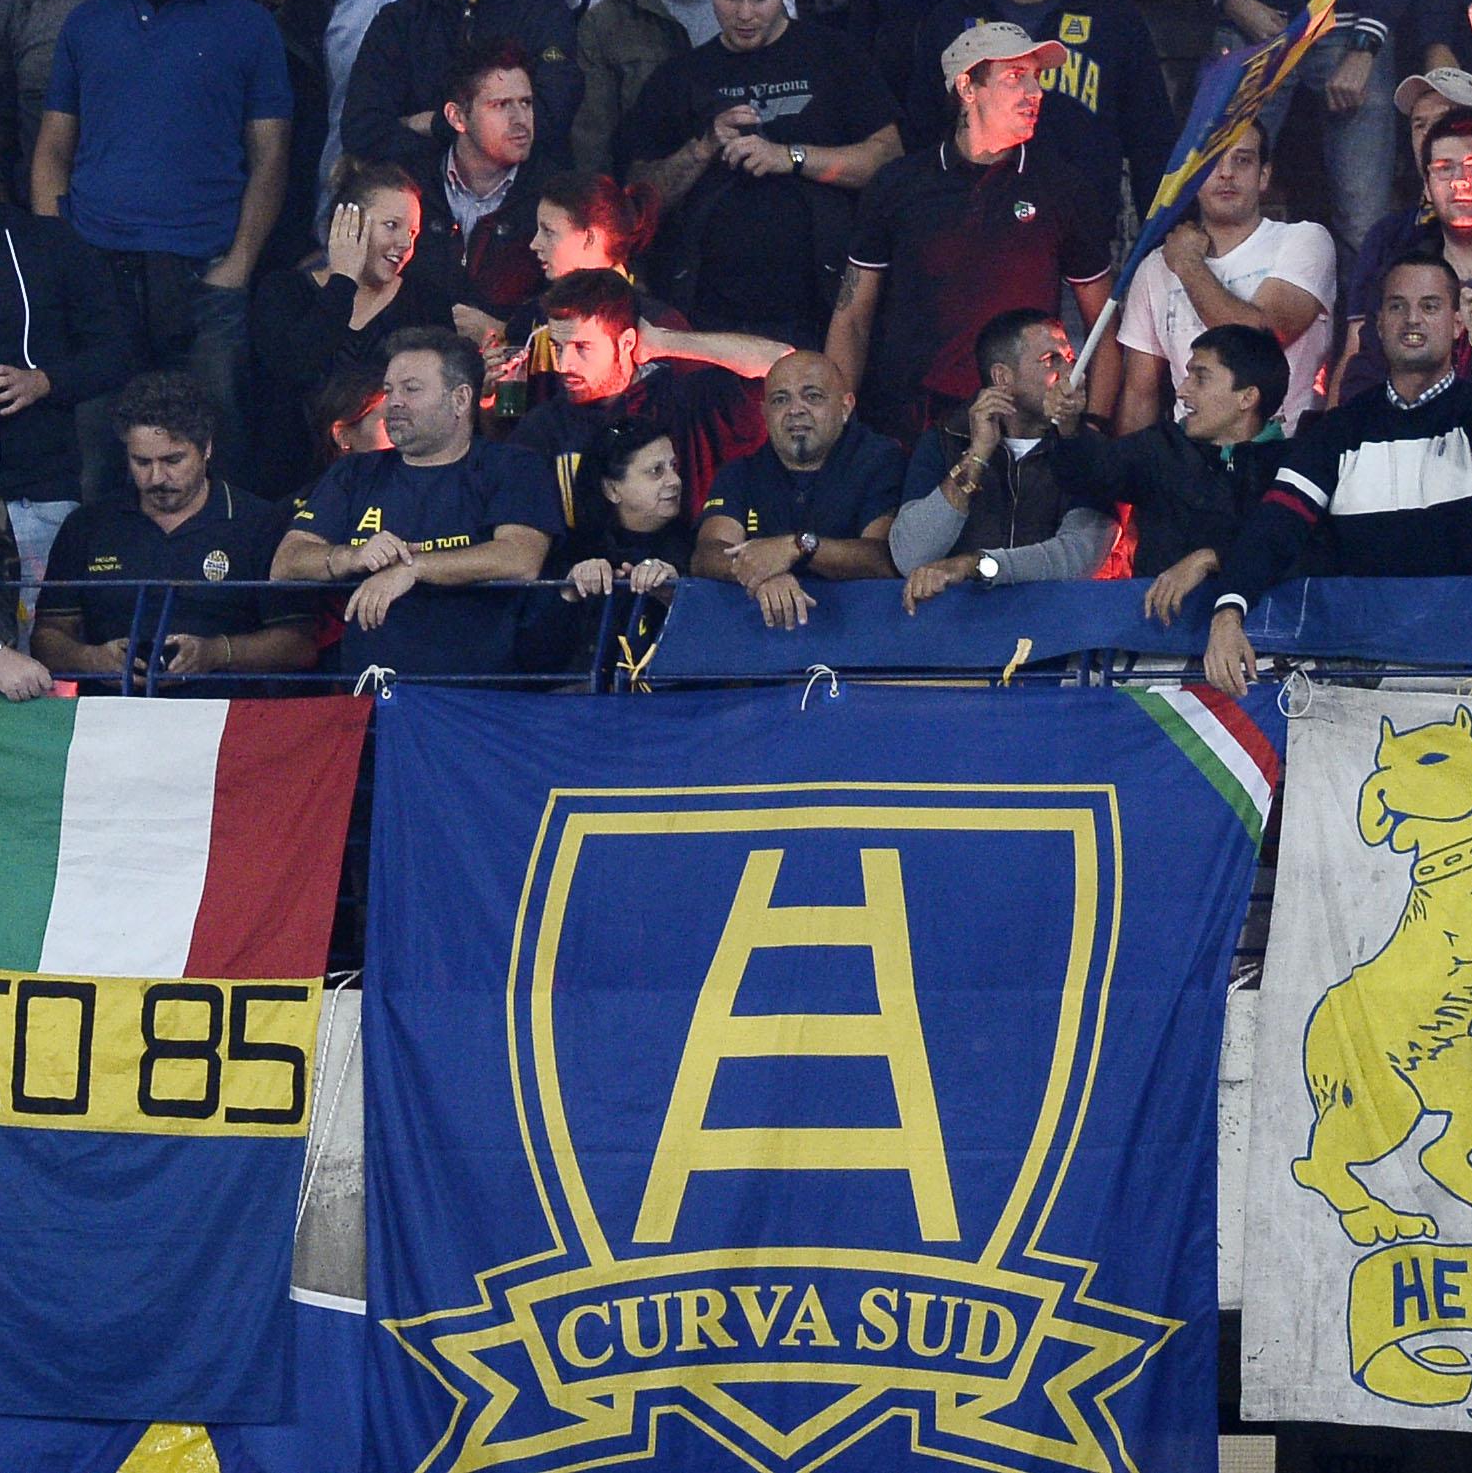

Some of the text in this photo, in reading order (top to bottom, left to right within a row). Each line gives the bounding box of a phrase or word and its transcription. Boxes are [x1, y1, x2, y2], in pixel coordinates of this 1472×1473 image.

[749, 79, 809, 98] Verona
[436, 535, 470, 550] TUTTI
[137, 981, 308, 1125] 85
[557, 1284, 1017, 1369] CURVA SUD
